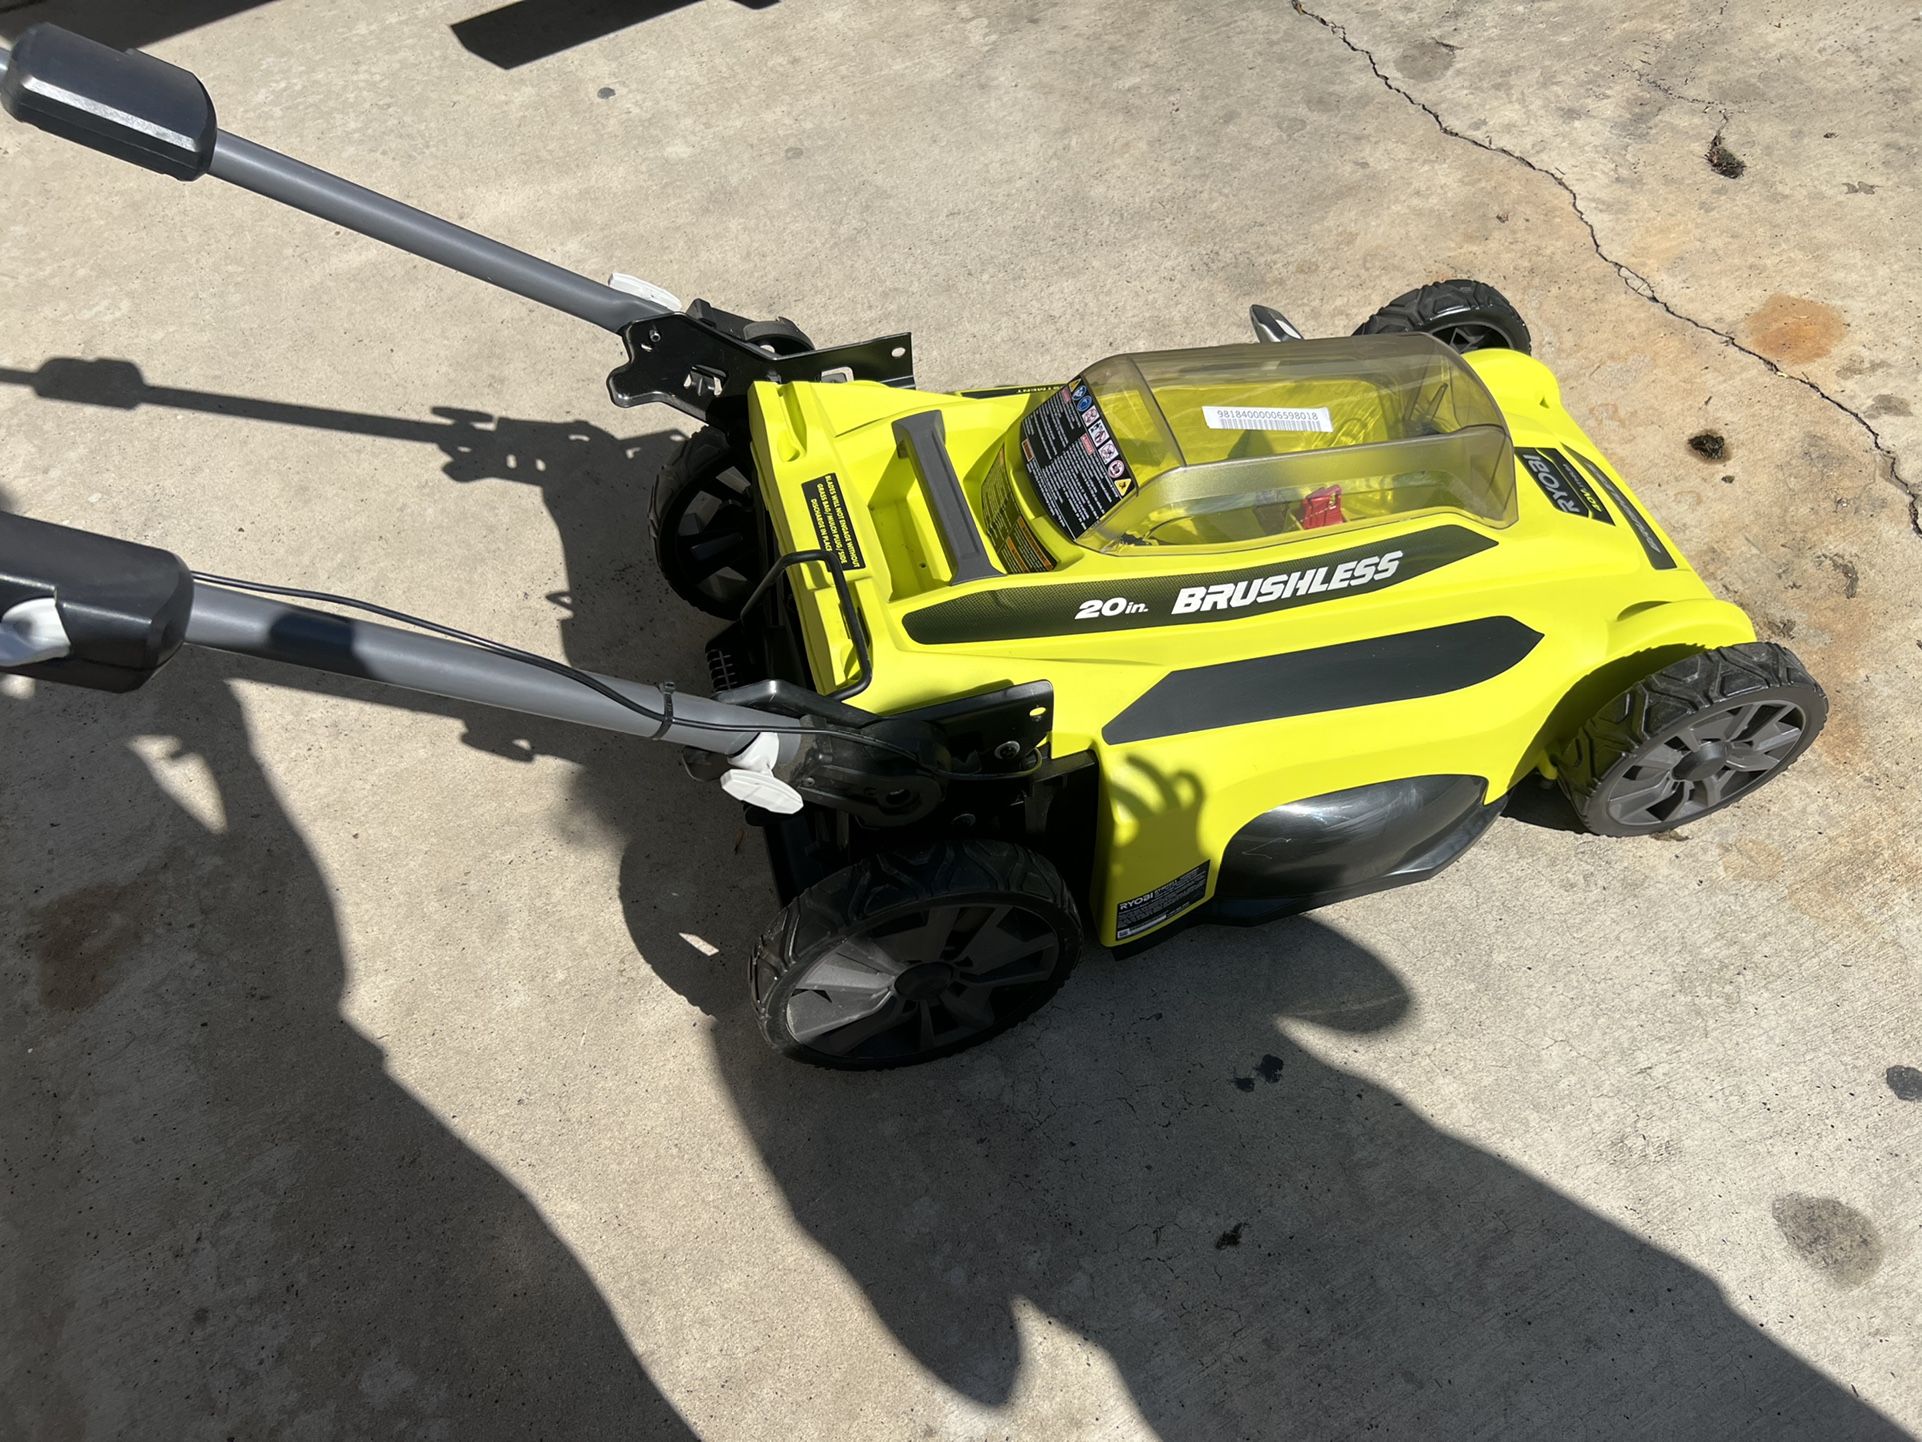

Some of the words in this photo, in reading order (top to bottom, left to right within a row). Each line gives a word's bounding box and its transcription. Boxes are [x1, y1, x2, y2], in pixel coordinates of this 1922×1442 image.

[1217, 409, 1318, 420] 98184000006598018
[817, 483, 828, 501] GRASS
[825, 475, 836, 495] BLADES
[1522, 454, 1580, 512] RYOBI
[822, 499, 831, 513] BAG
[831, 494, 841, 508] WILL
[835, 507, 845, 520] NOT
[827, 514, 838, 534] MULCH
[839, 519, 852, 542] ENGAGE
[832, 533, 843, 549] PLUG
[838, 551, 847, 564] SIDE
[847, 541, 860, 567] WITHOUT
[1171, 550, 1404, 615] BRUSHLESS
[1120, 892, 1153, 910] RYOBI
